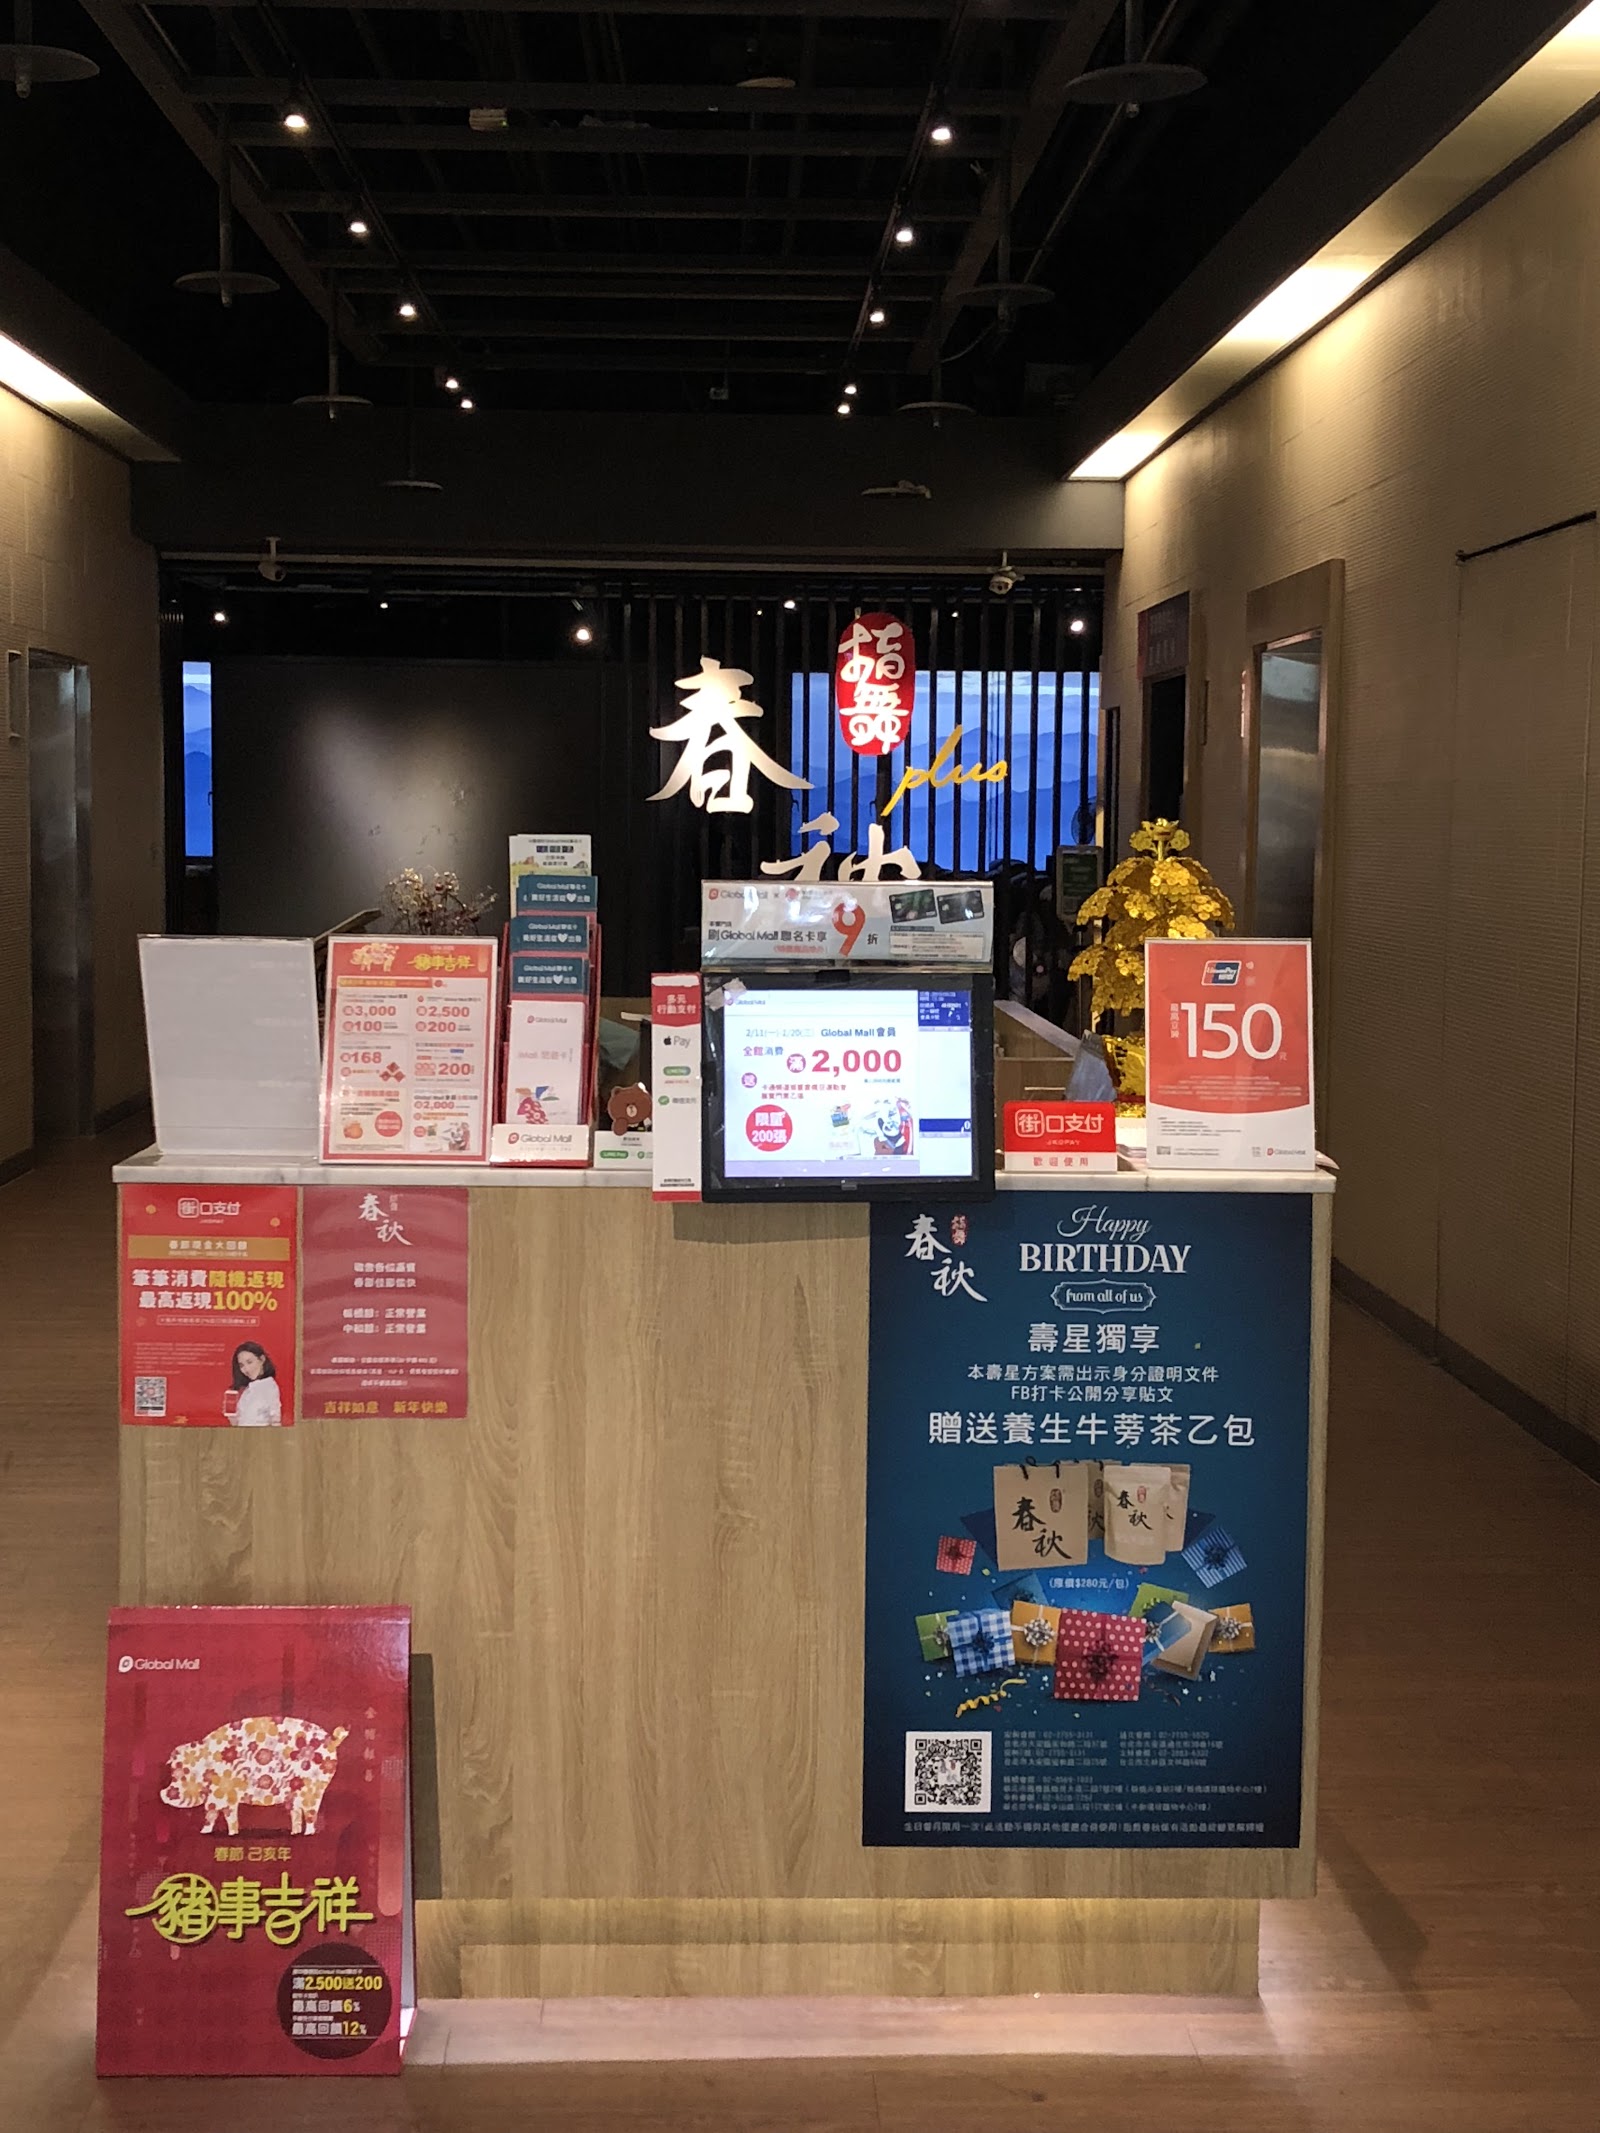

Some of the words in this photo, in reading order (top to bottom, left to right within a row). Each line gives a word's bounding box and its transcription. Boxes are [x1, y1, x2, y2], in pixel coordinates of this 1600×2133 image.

[880, 723, 1009, 818] plus
[720, 930, 755, 942] Global
[757, 931, 780, 941] Mall
[832, 902, 866, 957] 9
[867, 933, 878, 945] 折
[355, 1021, 382, 1032] 100
[428, 1022, 456, 1032] 200
[821, 1029, 851, 1037] Global
[855, 1029, 874, 1037] Mall
[1181, 1002, 1282, 1060] 150
[673, 1035, 691, 1049] Pay
[353, 1052, 382, 1063] 168
[812, 1049, 902, 1077] 2,000
[439, 1063, 471, 1076] 200
[1015, 1109, 1104, 1138] 街口支付
[520, 1134, 551, 1144] Global
[553, 1134, 572, 1143] Mall
[178, 1198, 241, 1218] 街口支付
[1057, 1205, 1151, 1242] Happy
[1019, 1243, 1192, 1274] BIRTHDAY
[139, 1291, 277, 1311] 最高返現100%
[1065, 1289, 1094, 1304] from
[1097, 1288, 1112, 1303] all
[1114, 1288, 1127, 1304] of
[1128, 1292, 1143, 1303] us
[1027, 1323, 1160, 1354] 壽星獨享
[967, 1365, 1219, 1383] 本壽星方案需出示身分證明文件
[1010, 1386, 1173, 1403] FB打卡公開分享貼文
[928, 1411, 1256, 1446] 贈送養生牛蒡茶乙包
[134, 1657, 173, 1670] Global
[176, 1657, 200, 1670] Mall
[125, 1871, 374, 1945] 豬事吉祥
